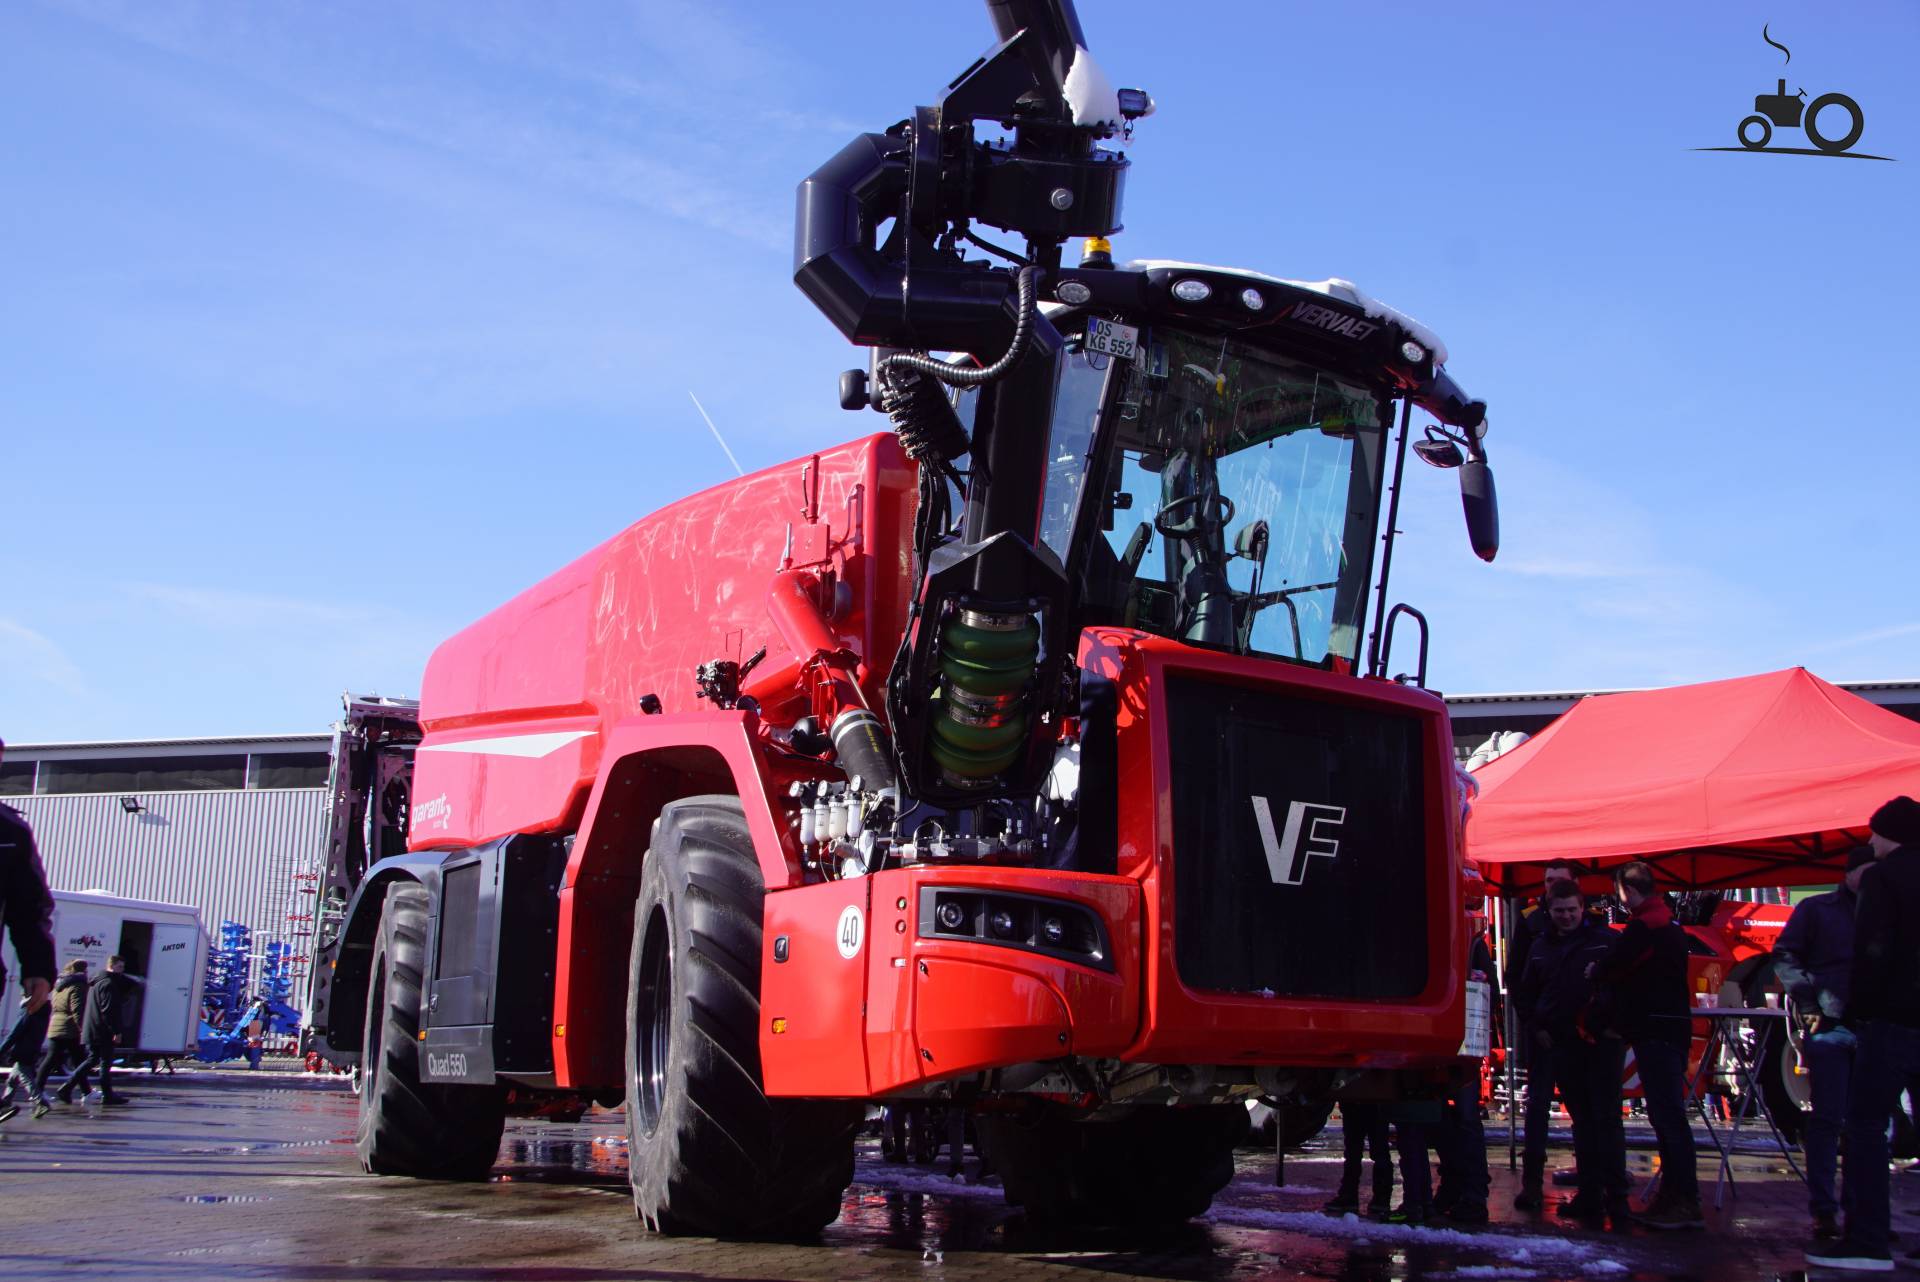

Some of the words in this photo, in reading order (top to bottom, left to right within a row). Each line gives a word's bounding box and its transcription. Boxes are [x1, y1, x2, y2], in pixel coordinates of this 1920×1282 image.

[1096, 320, 1112, 337] OS
[1290, 301, 1379, 340] VERVAET
[1090, 335, 1106, 350] KG
[1110, 339, 1133, 356] 552
[1251, 795, 1347, 885] VF
[842, 915, 858, 948] 40
[428, 1052, 450, 1077] Quad
[450, 1053, 467, 1077] 550
